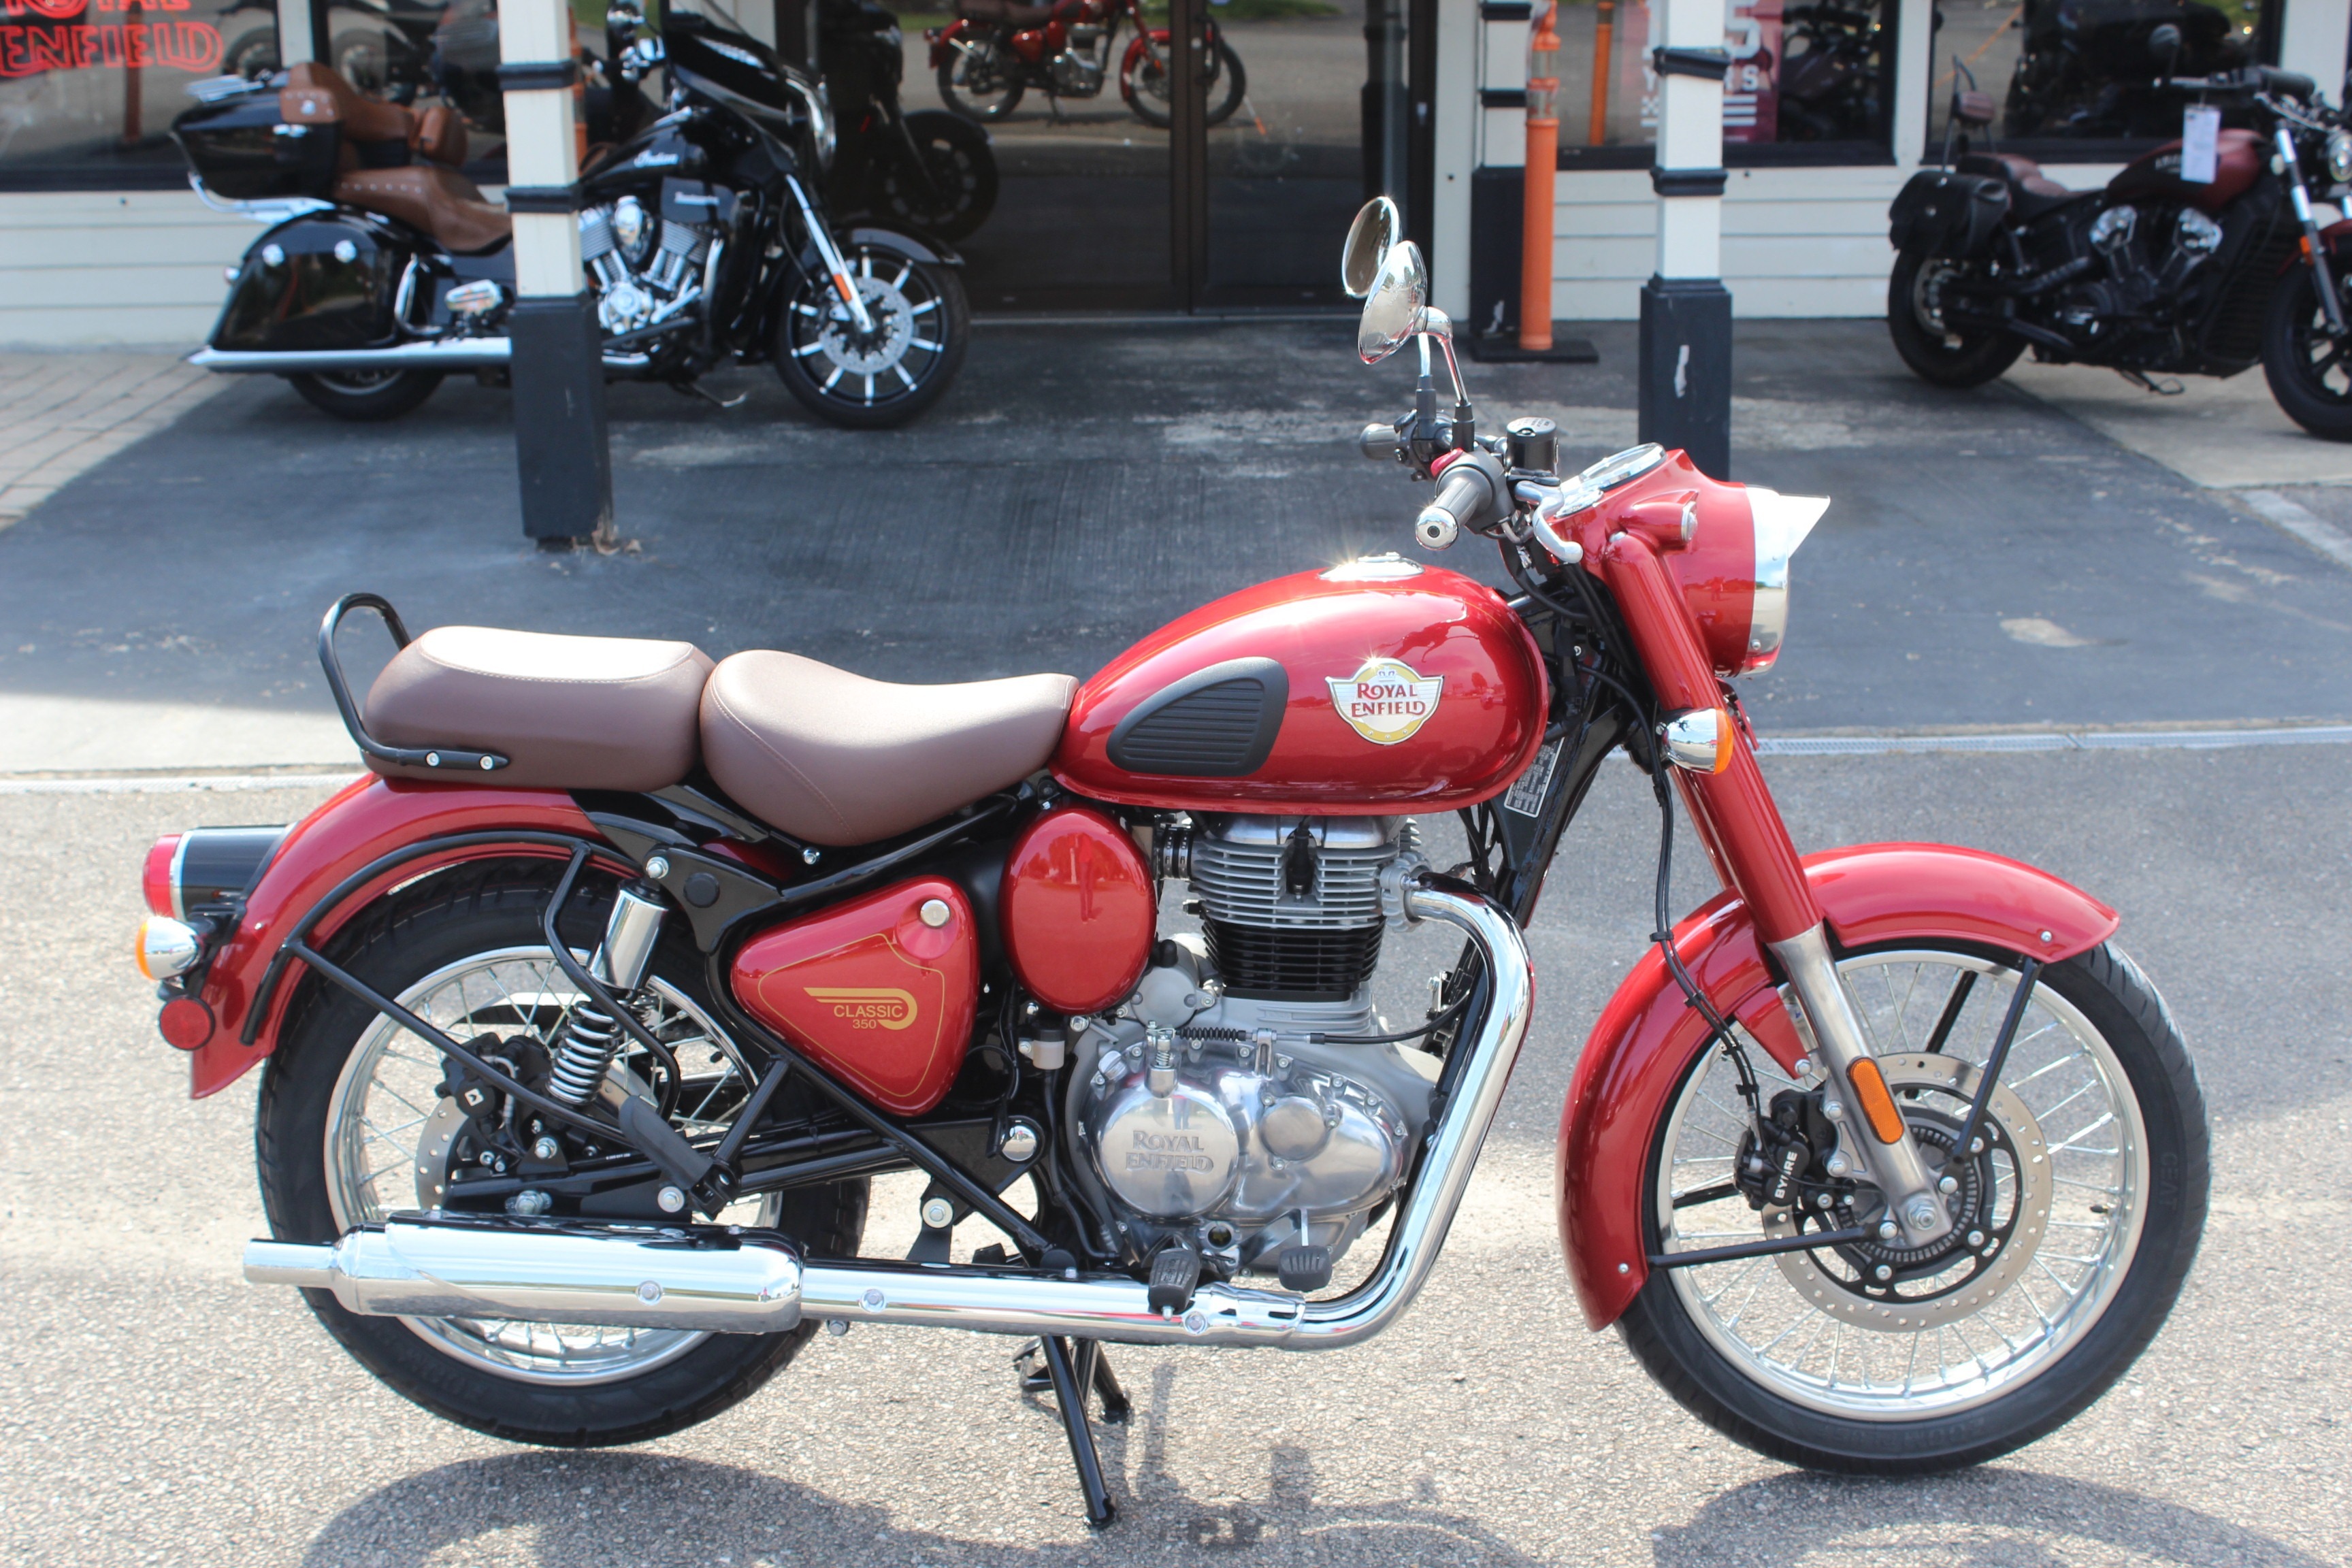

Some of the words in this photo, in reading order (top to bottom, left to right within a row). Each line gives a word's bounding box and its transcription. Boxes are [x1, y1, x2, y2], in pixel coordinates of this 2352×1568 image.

[0, 21, 224, 78] ENFIELD
[1357, 683, 1418, 700] ROYAL
[1351, 700, 1426, 717] ENFIELD
[833, 1004, 903, 1018] CLASSIC
[852, 1019, 877, 1029] 350
[1132, 1130, 1205, 1153] ROYAL
[1126, 1152, 1214, 1175] ENFIELD
